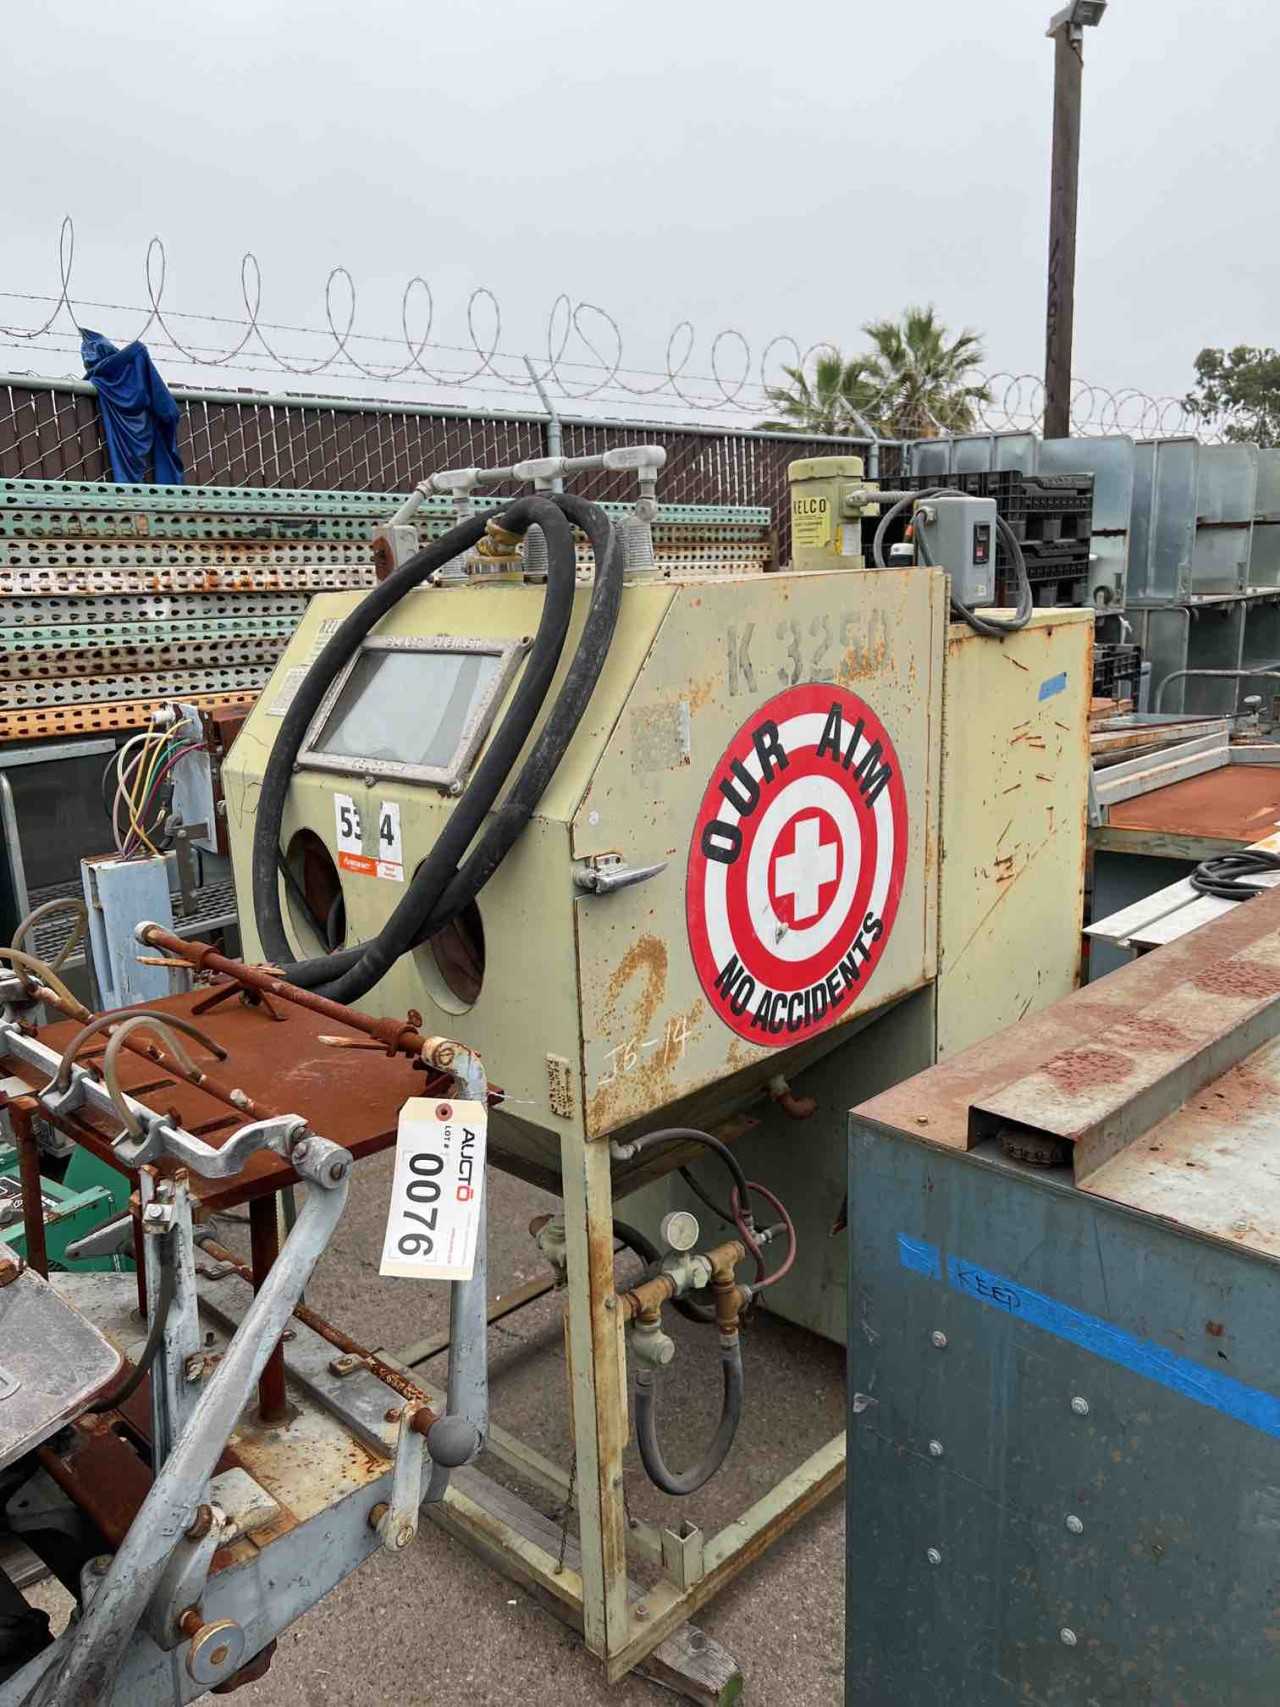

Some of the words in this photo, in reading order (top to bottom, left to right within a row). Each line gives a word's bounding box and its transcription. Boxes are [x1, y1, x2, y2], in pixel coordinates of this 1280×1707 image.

[728, 623, 758, 696] K
[702, 719, 790, 864] OUR
[816, 702, 893, 809] AIM
[714, 953, 755, 1016] NO
[750, 911, 884, 1035] ACCIDENTS
[443, 1125, 453, 1142] LOT
[398, 1153, 444, 1256] 0076
[957, 1264, 1021, 1313] KEEP
